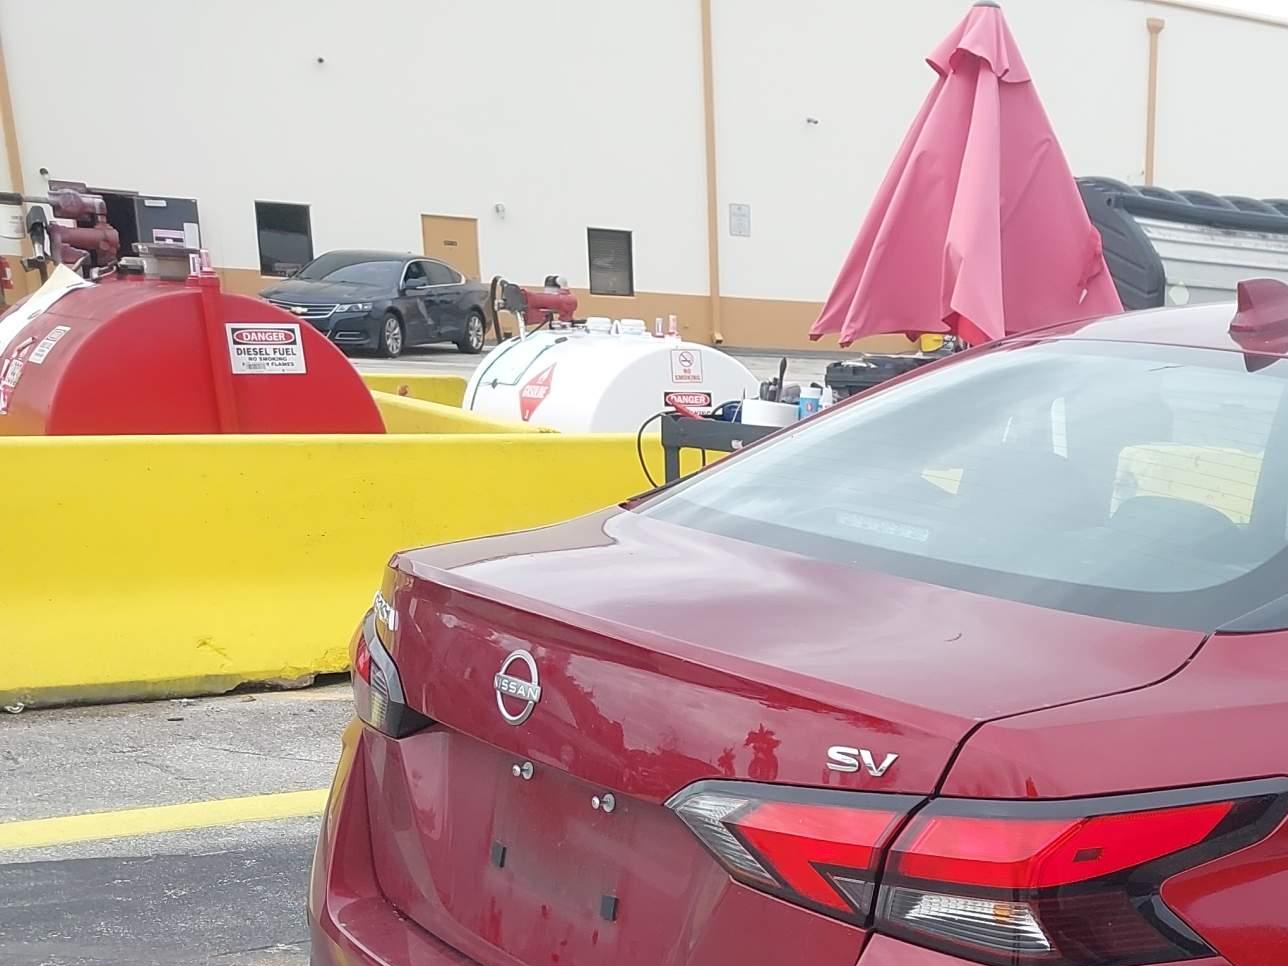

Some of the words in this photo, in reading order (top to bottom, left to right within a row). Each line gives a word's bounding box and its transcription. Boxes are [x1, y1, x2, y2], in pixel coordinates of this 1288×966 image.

[242, 332, 286, 341] DANGER
[236, 347, 270, 356] DIESEL
[272, 347, 297, 356] FUEL
[670, 395, 706, 404] DANGER
[826, 746, 899, 776] SV
